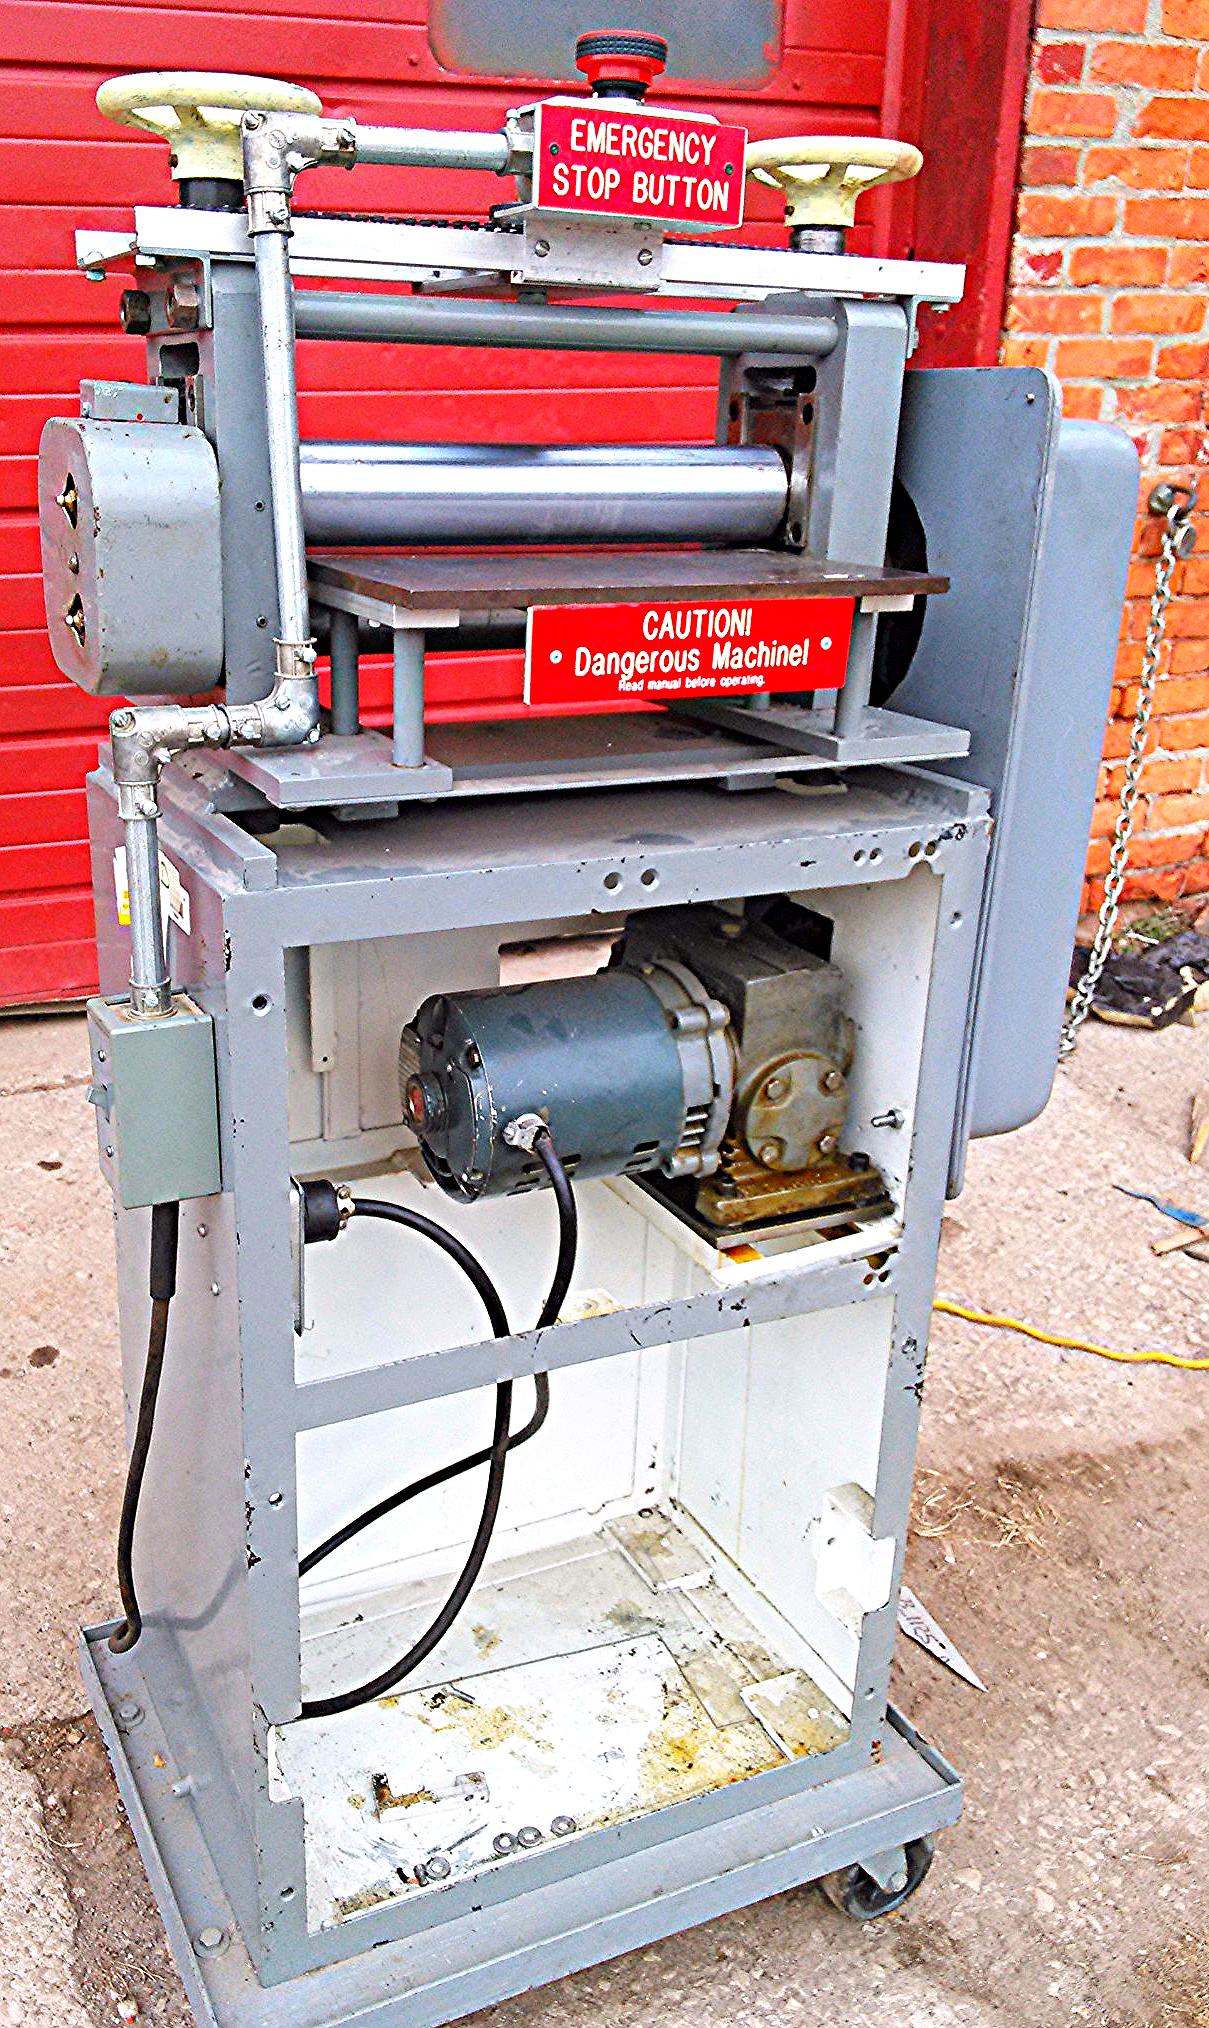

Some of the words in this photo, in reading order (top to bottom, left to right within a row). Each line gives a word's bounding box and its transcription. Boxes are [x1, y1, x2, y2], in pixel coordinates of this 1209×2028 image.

[571, 118, 716, 166] EMERGENCY
[553, 162, 621, 200] STOP
[632, 170, 730, 212] BUTTON
[642, 608, 753, 641] CAUTION!
[574, 646, 701, 680] Dangerous
[711, 638, 810, 670] Machine!
[618, 679, 645, 692] Read
[647, 678, 682, 690] manual
[685, 675, 717, 688] before
[719, 674, 766, 688] operating.
